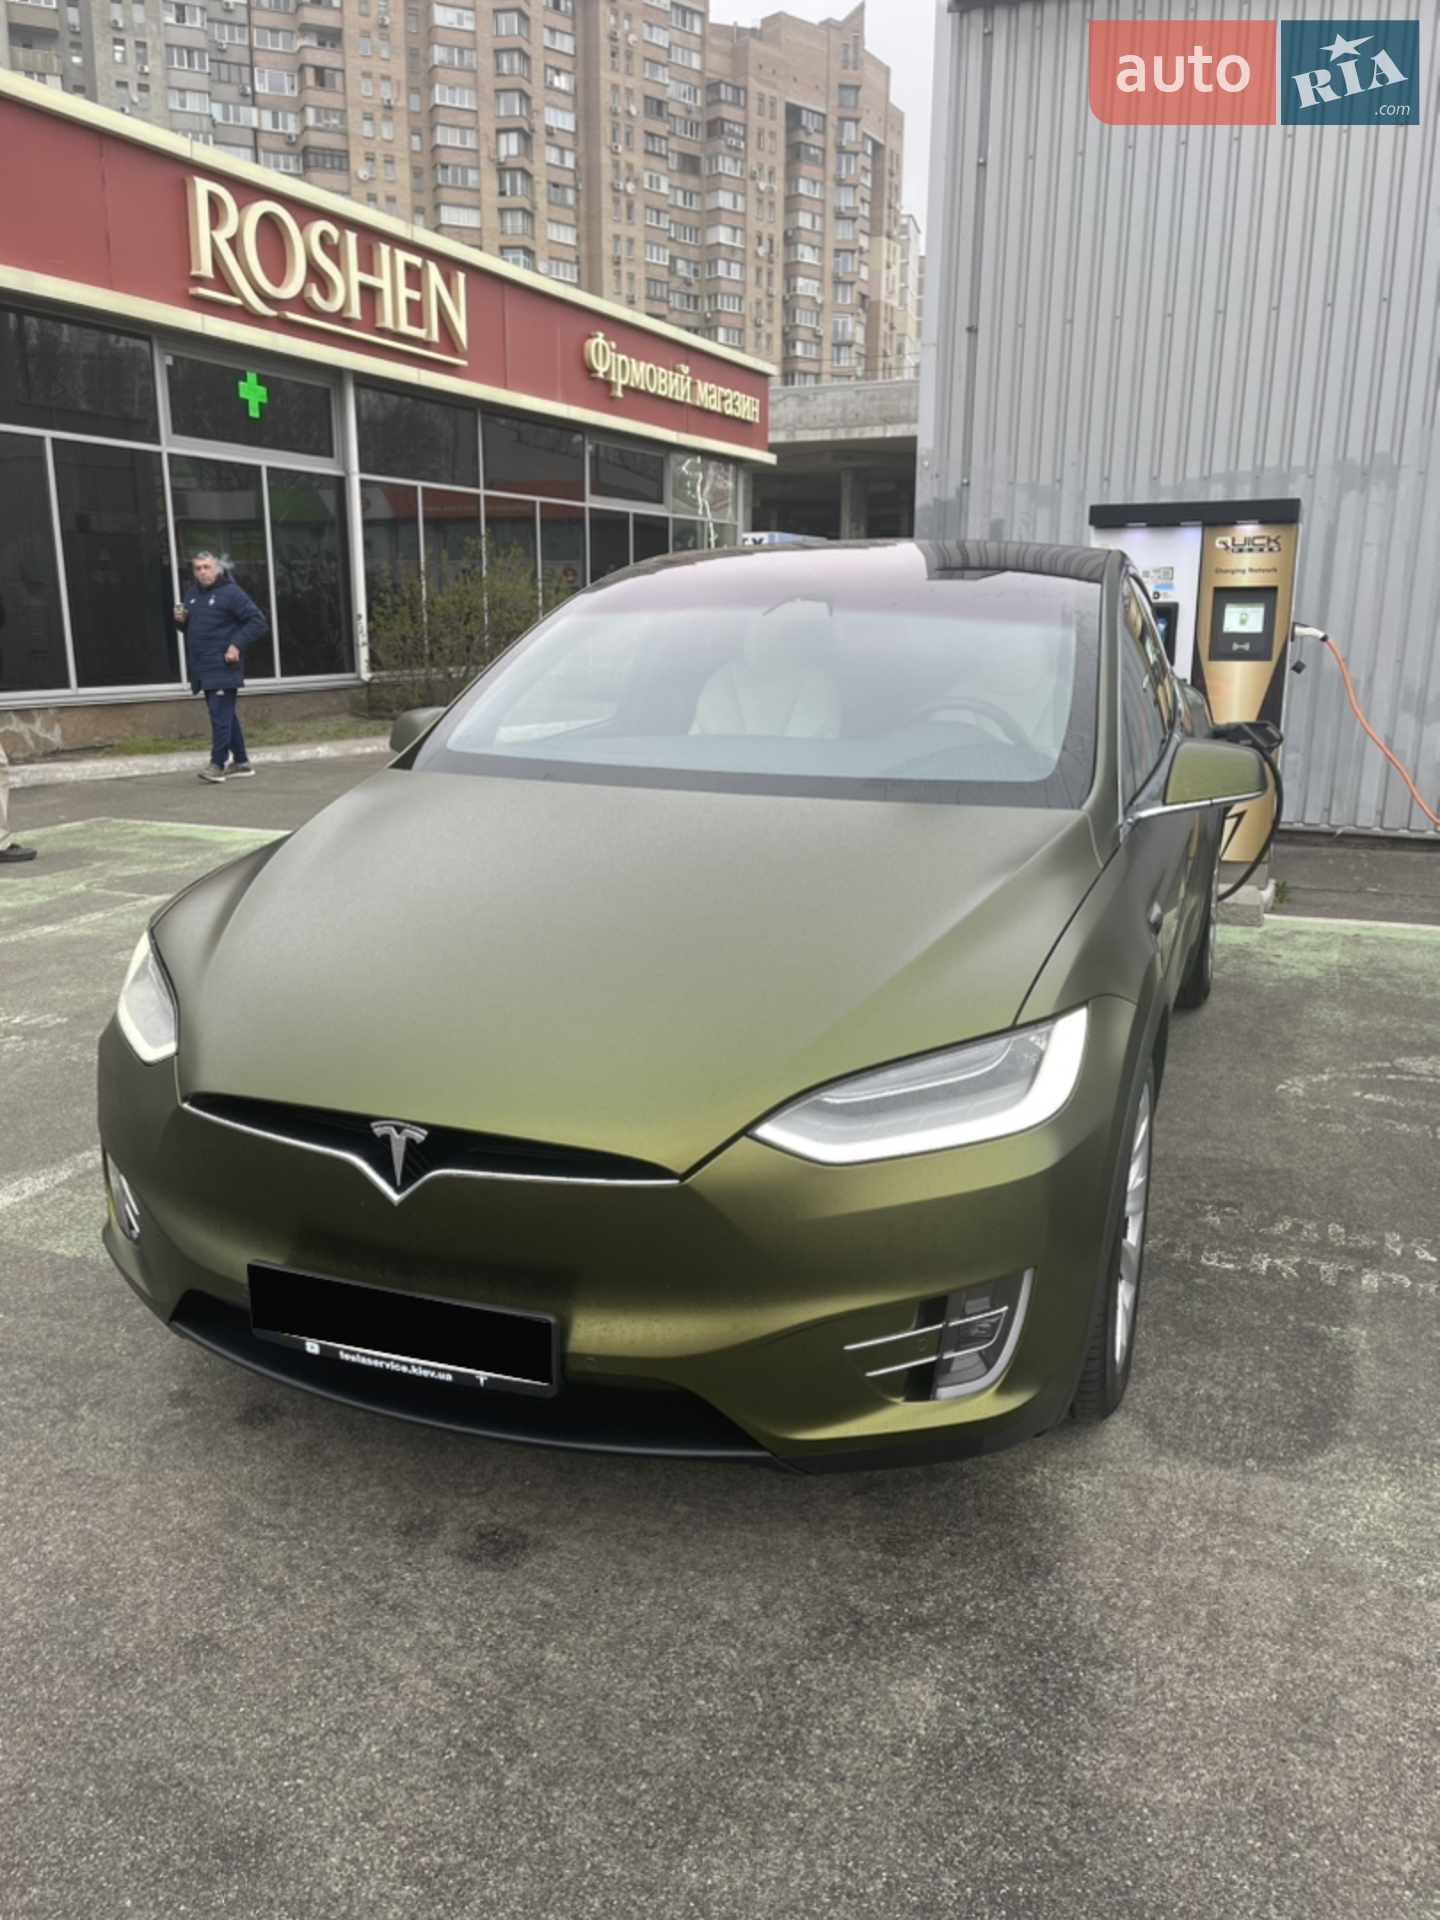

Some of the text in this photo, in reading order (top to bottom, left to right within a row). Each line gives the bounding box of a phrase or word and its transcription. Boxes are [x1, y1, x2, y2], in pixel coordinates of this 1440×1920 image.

[185, 175, 468, 352] ROSHEN
[585, 332, 761, 424] Фірмовий магазин
[1215, 534, 1282, 551] QUICK
[1214, 566, 1278, 575] Charging Network
[339, 1350, 453, 1382] teslaservice.kiev.ua
